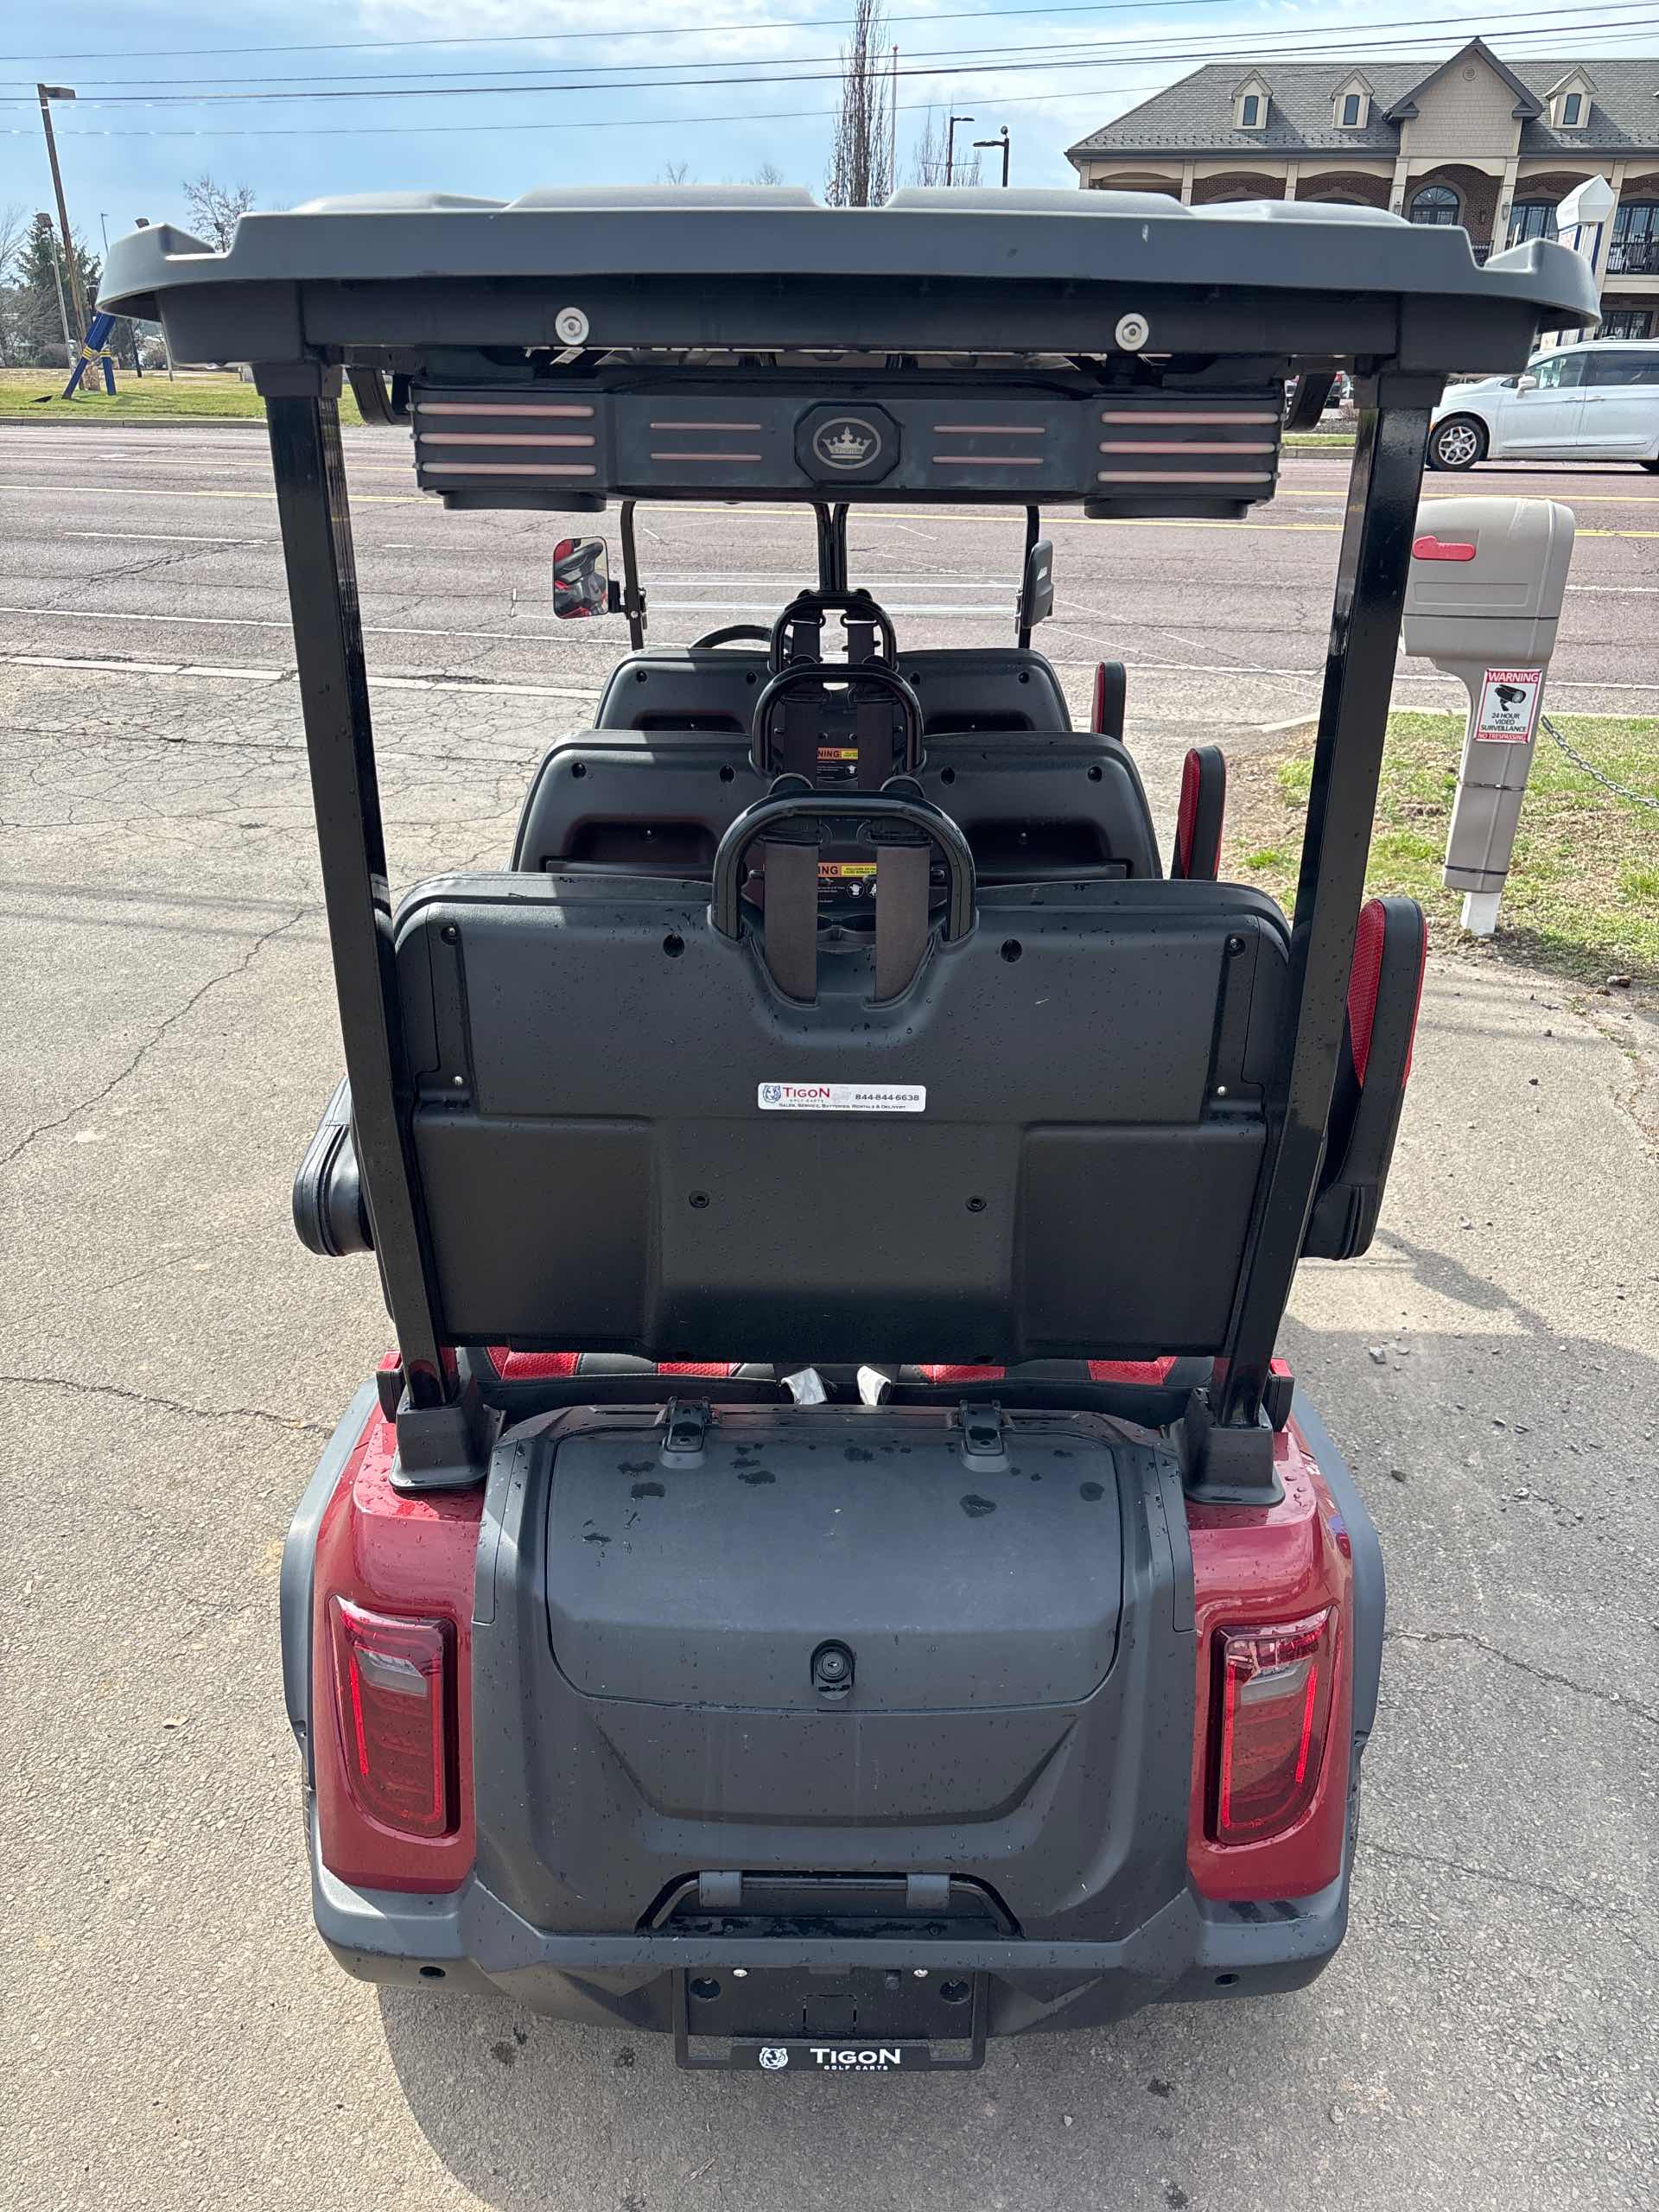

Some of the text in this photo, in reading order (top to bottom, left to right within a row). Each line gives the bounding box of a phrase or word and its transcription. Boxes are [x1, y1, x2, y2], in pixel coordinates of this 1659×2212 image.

[1489, 672, 1539, 683] WARNING
[783, 1087, 830, 1098] TIGON
[810, 2048, 900, 2063] TIGON
